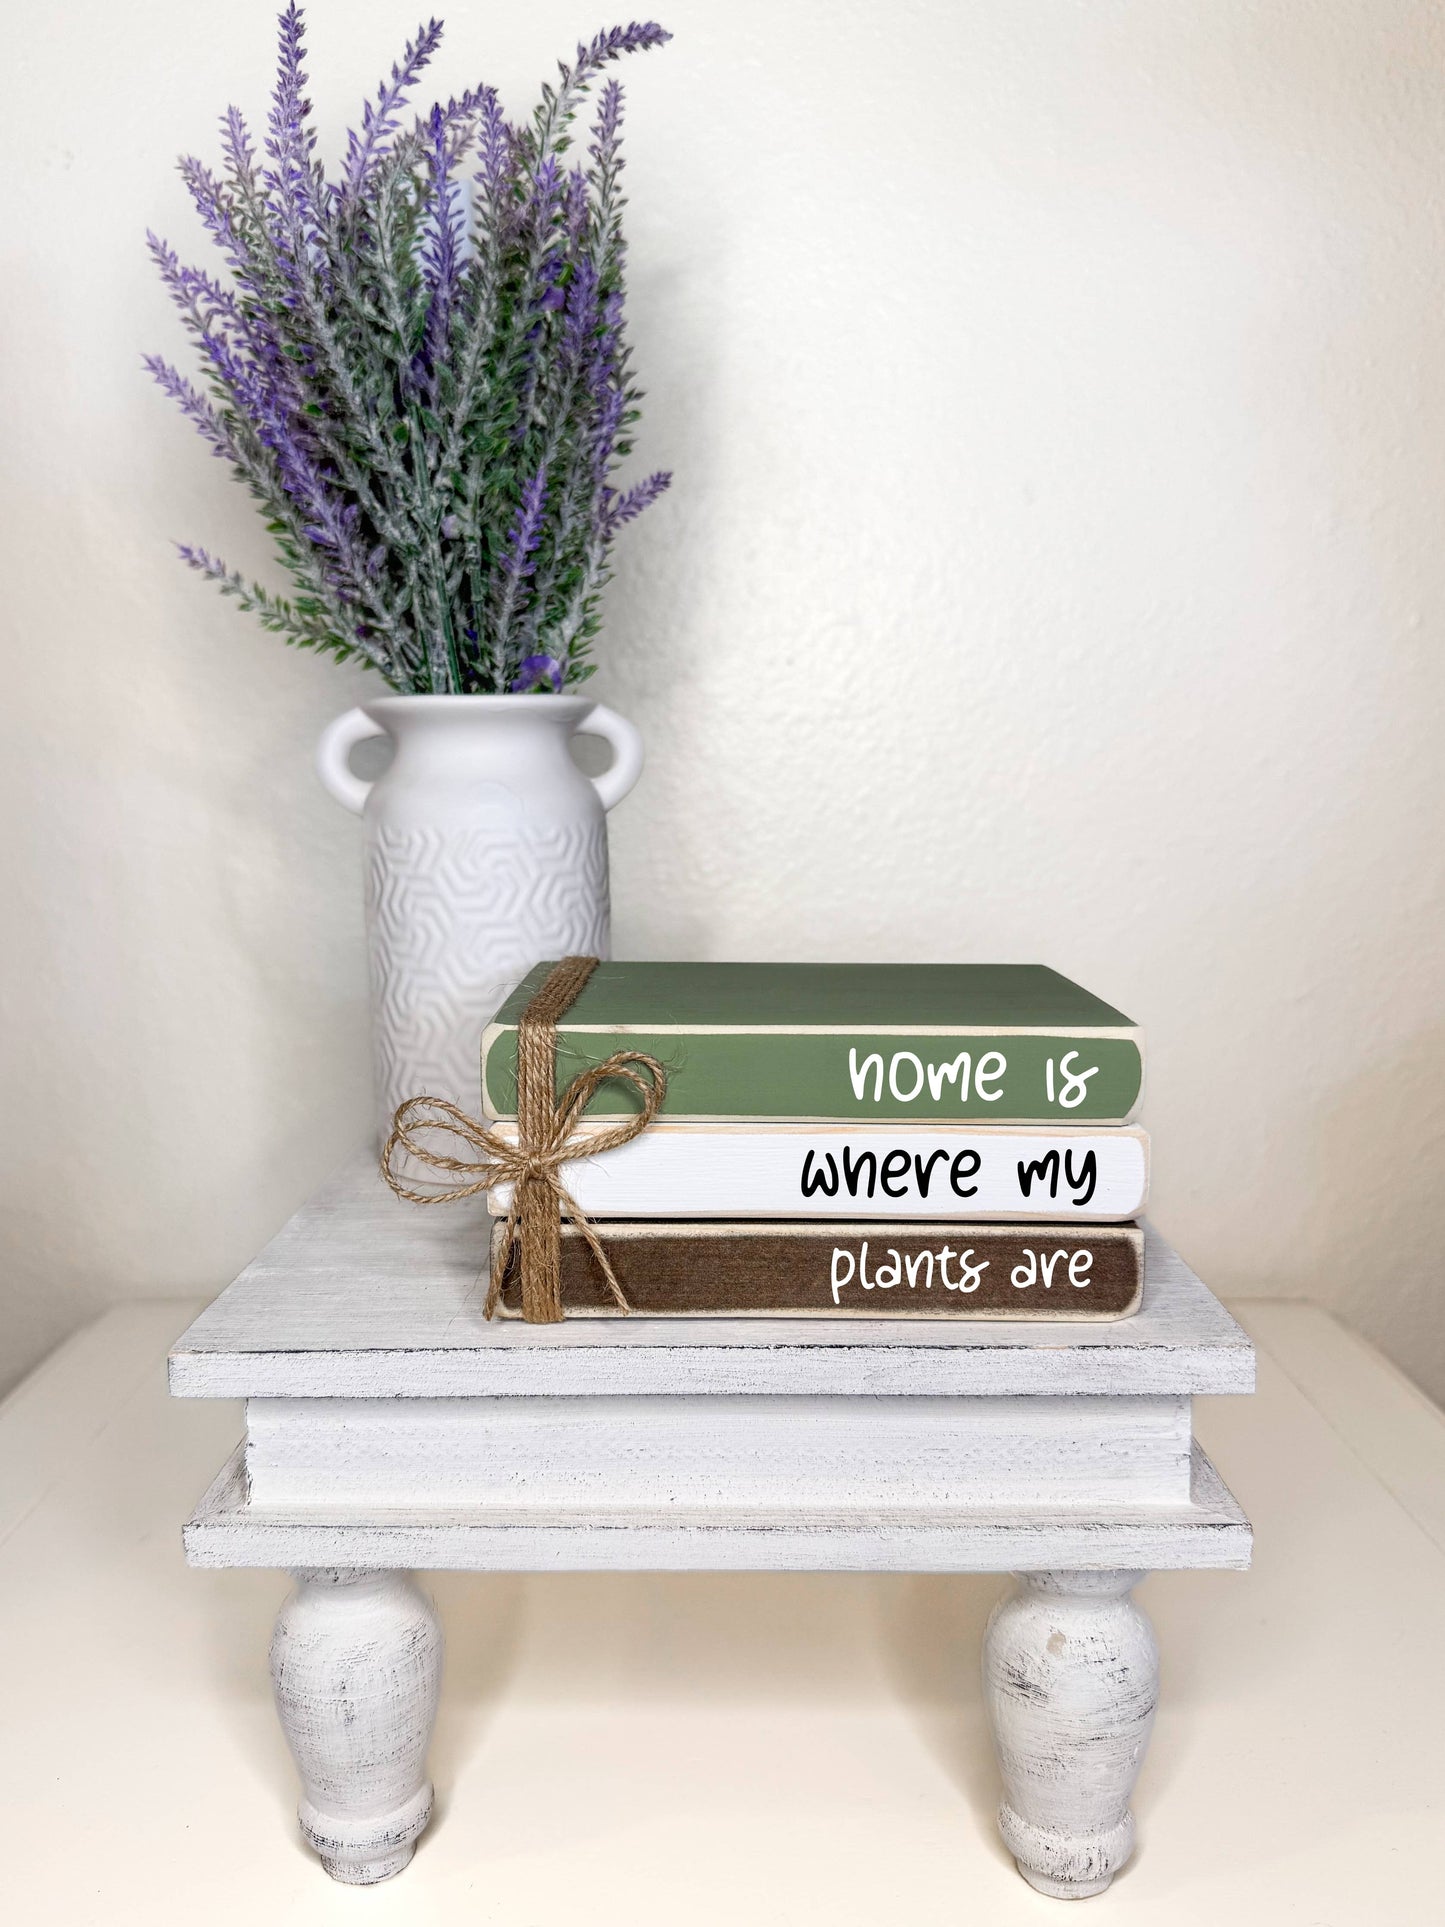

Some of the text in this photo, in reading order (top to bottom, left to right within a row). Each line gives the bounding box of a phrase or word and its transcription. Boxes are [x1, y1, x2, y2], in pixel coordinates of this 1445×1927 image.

[848, 1047, 1099, 1109] home is
[800, 1145, 1097, 1207] where my
[830, 1241, 1094, 1305] plants are
